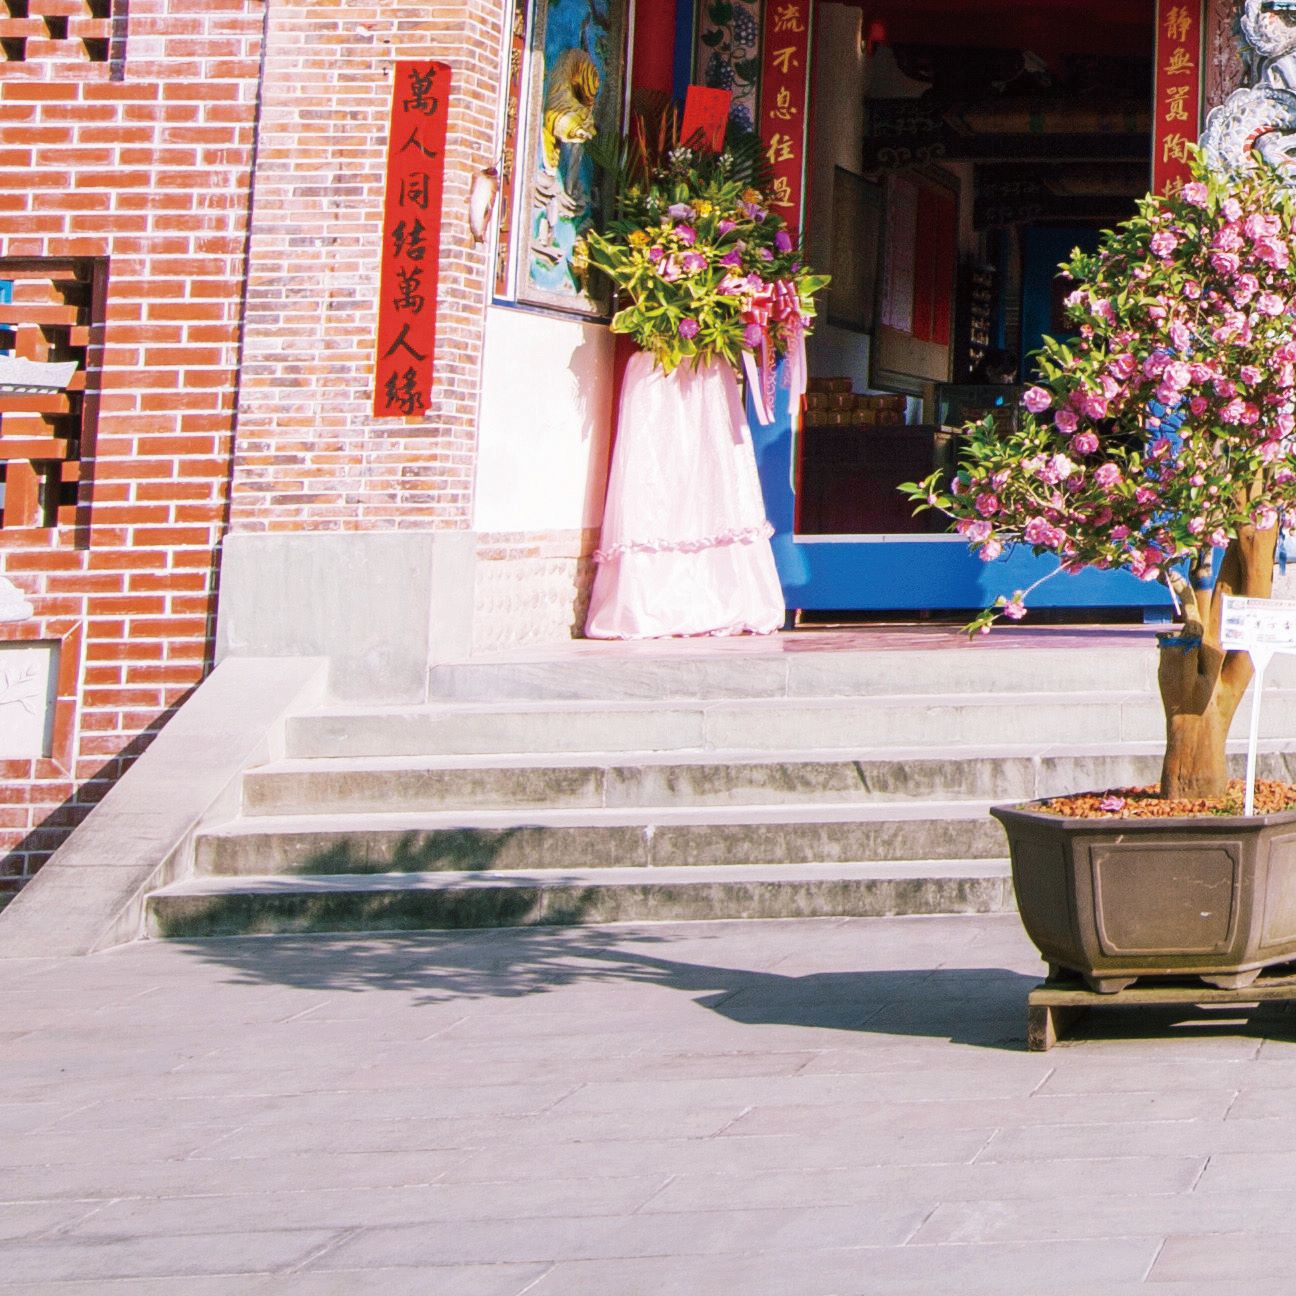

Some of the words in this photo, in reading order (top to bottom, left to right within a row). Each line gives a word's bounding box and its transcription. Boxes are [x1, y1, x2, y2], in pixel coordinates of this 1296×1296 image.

[382, 65, 439, 416] 萬人同結萬人緣
